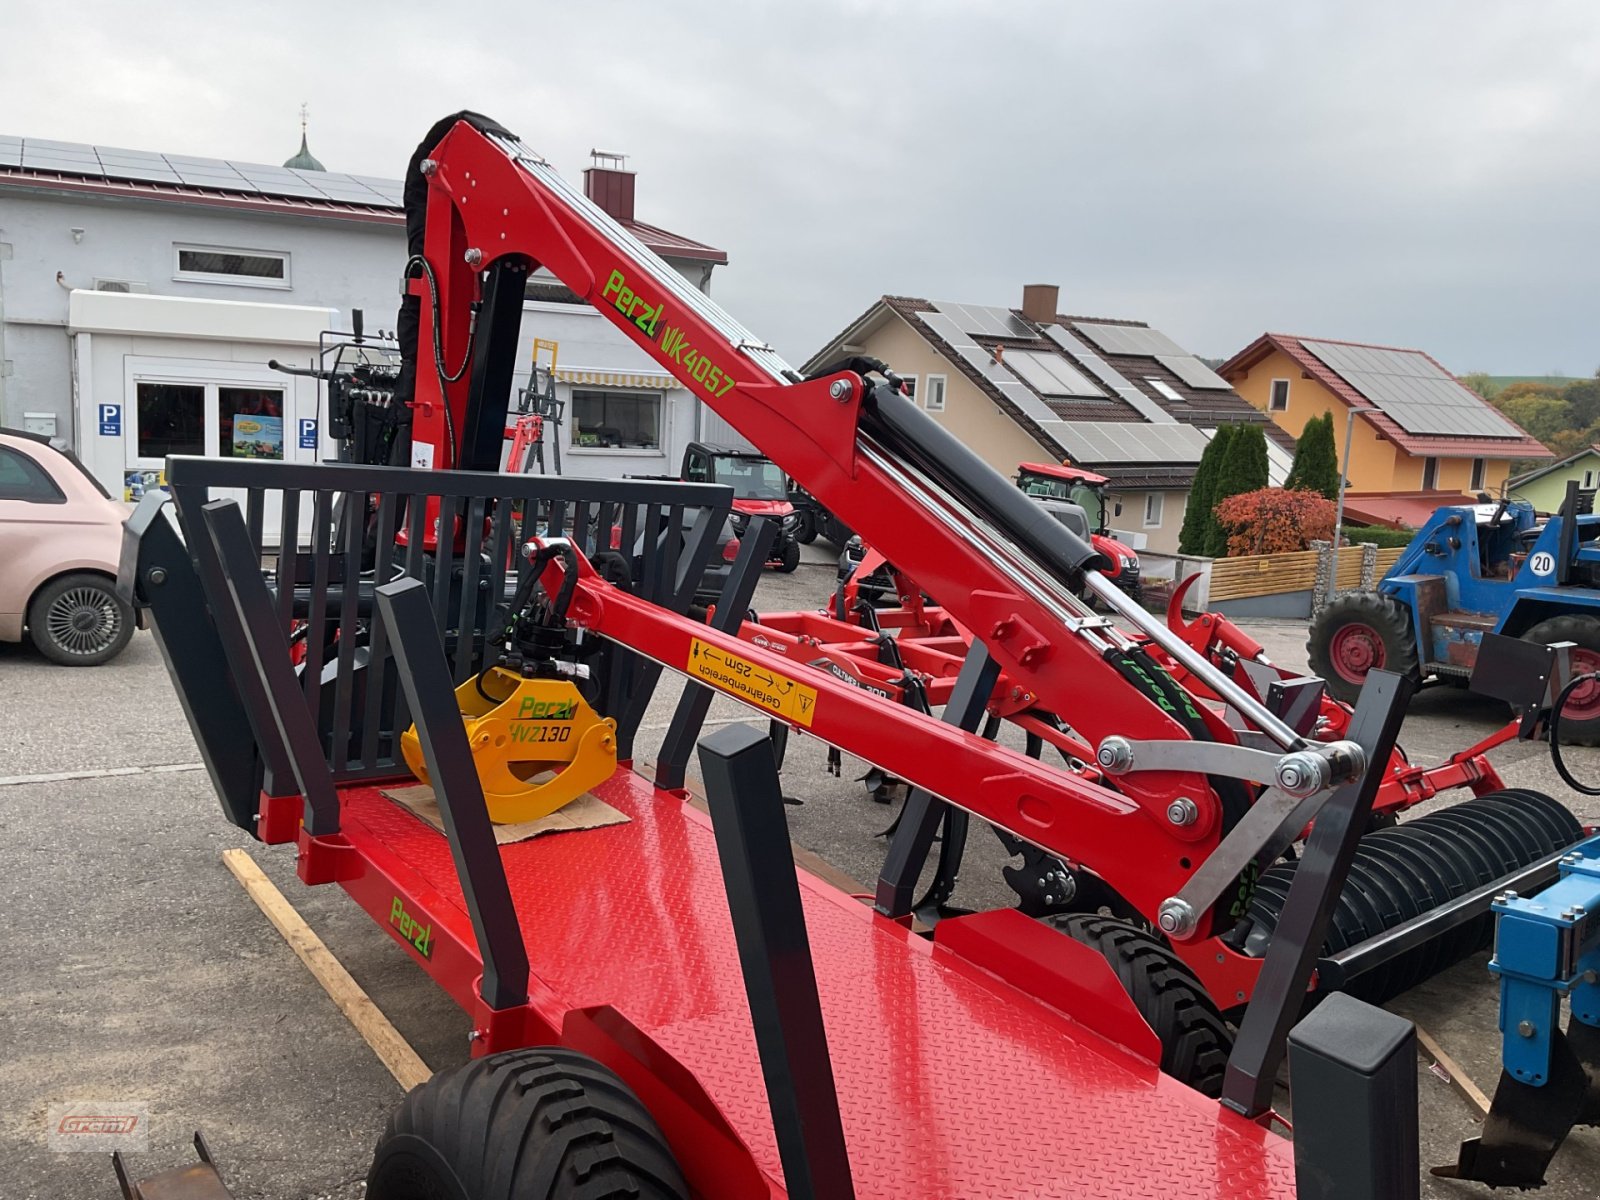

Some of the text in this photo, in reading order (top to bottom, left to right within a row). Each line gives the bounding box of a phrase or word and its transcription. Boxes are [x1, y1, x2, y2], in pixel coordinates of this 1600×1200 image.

[602, 269, 664, 337] Perzl
[103, 405, 117, 422] P
[303, 420, 316, 436] P
[1534, 556, 1550, 571] 20
[724, 656, 752, 678] 25m
[699, 664, 781, 709] Gefahrenbereich
[1121, 659, 1176, 711] Perzl
[518, 696, 573, 718] Perzl
[390, 895, 431, 957] Perzl
